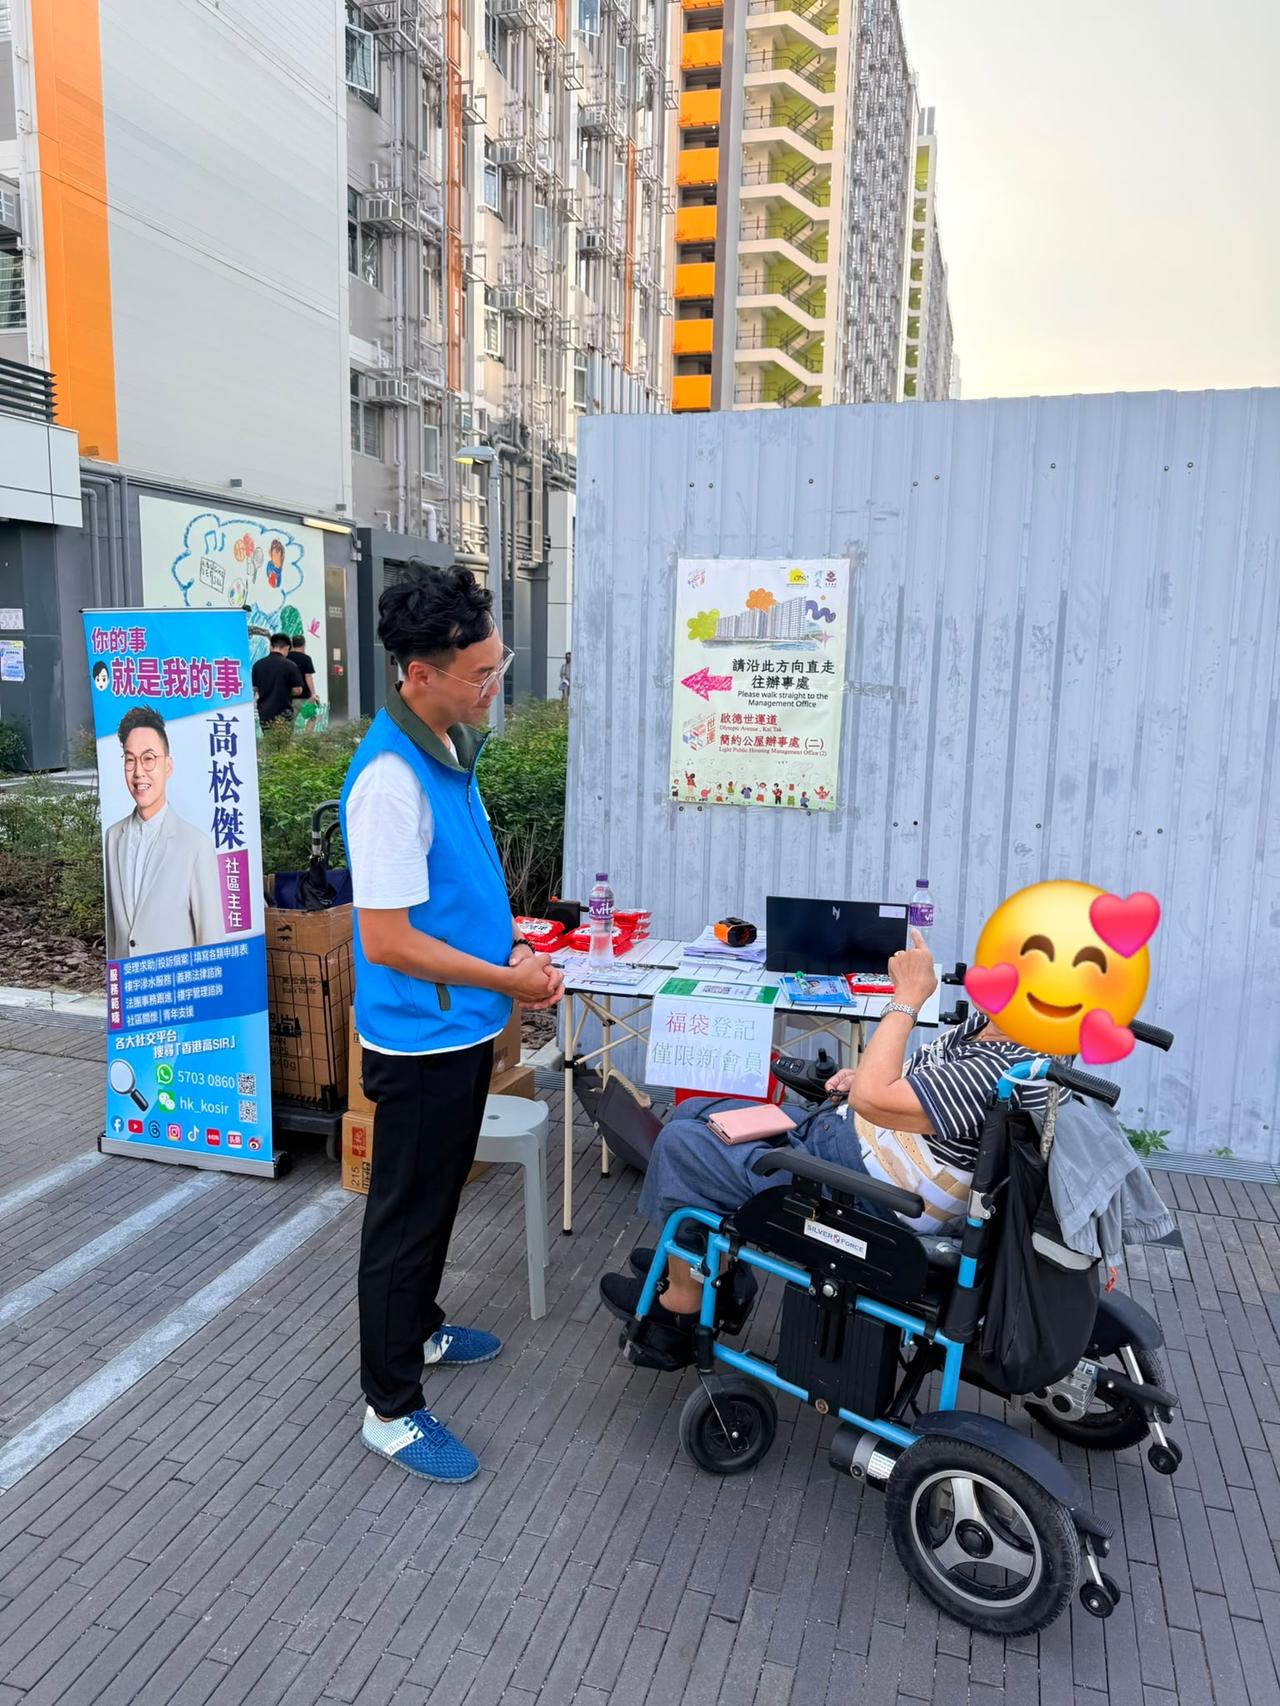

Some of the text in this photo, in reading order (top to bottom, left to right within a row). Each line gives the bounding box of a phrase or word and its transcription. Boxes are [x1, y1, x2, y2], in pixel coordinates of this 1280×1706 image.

[91, 626, 146, 654] 你的事
[732, 658, 835, 674] 請沿此方向直走
[111, 657, 243, 699] 就是我的事
[751, 675, 810, 690] 往辦事處
[748, 699, 817, 708] Management Office
[779, 692, 806, 700] straight
[816, 692, 829, 700] the
[720, 734, 800, 748] 簡約公屋辦事處
[770, 748, 802, 756] Management
[206, 713, 247, 850] 高松傑
[225, 857, 242, 928] 社區主任
[666, 1011, 755, 1041] 福袋登記
[115, 1029, 177, 1050] 各大社交平台
[652, 1042, 762, 1074] 僅限新會員
[178, 1070, 235, 1089] 5703 0860
[180, 1096, 229, 1115] hk_kosir
[807, 1224, 864, 1253] SILVER FORCE
